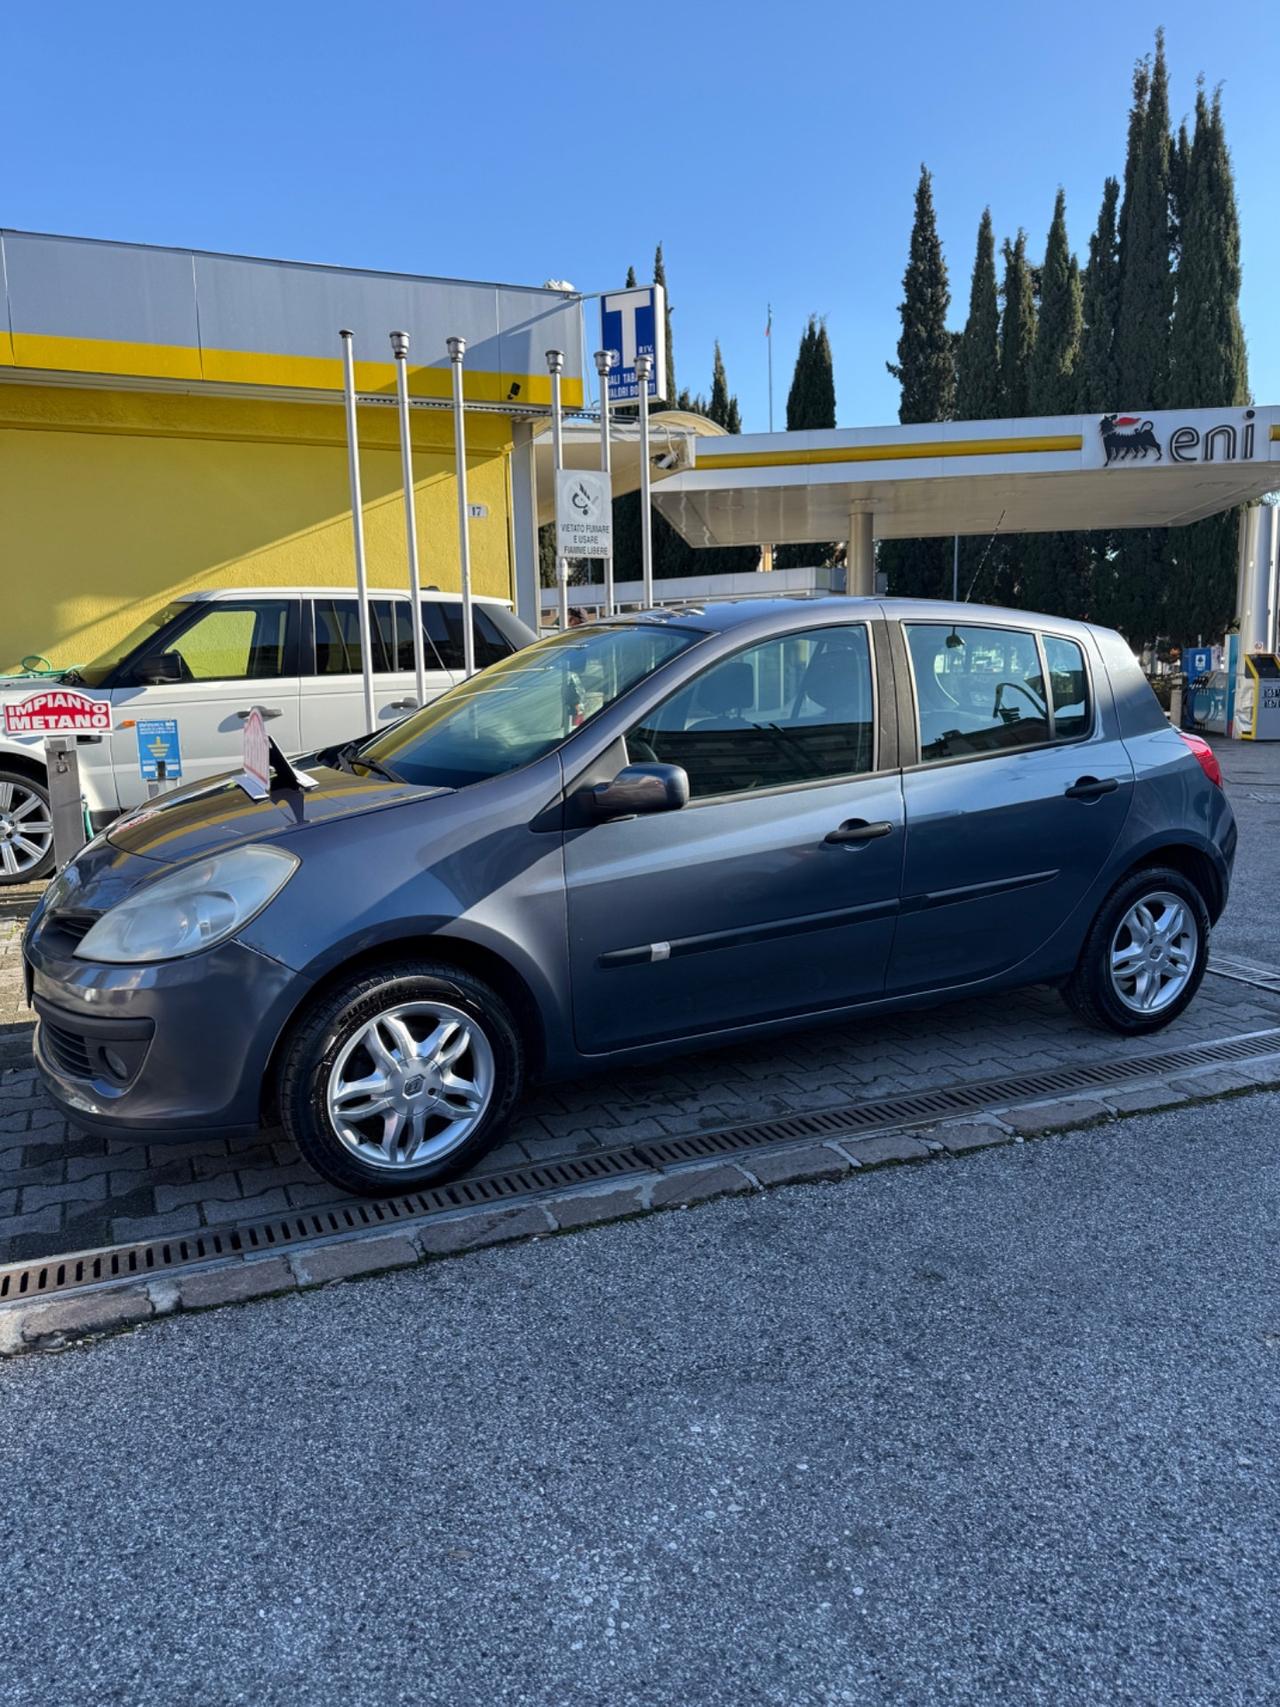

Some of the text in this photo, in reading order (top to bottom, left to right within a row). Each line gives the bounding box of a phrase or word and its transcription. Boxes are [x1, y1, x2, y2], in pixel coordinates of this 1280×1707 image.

[605, 290, 651, 368] T
[1169, 409, 1256, 462] eni
[561, 523, 610, 534] VIETATO FUMARE
[573, 535, 599, 544] E USARE
[8, 694, 107, 716] IMPIANTO
[9, 714, 108, 730] METANO
